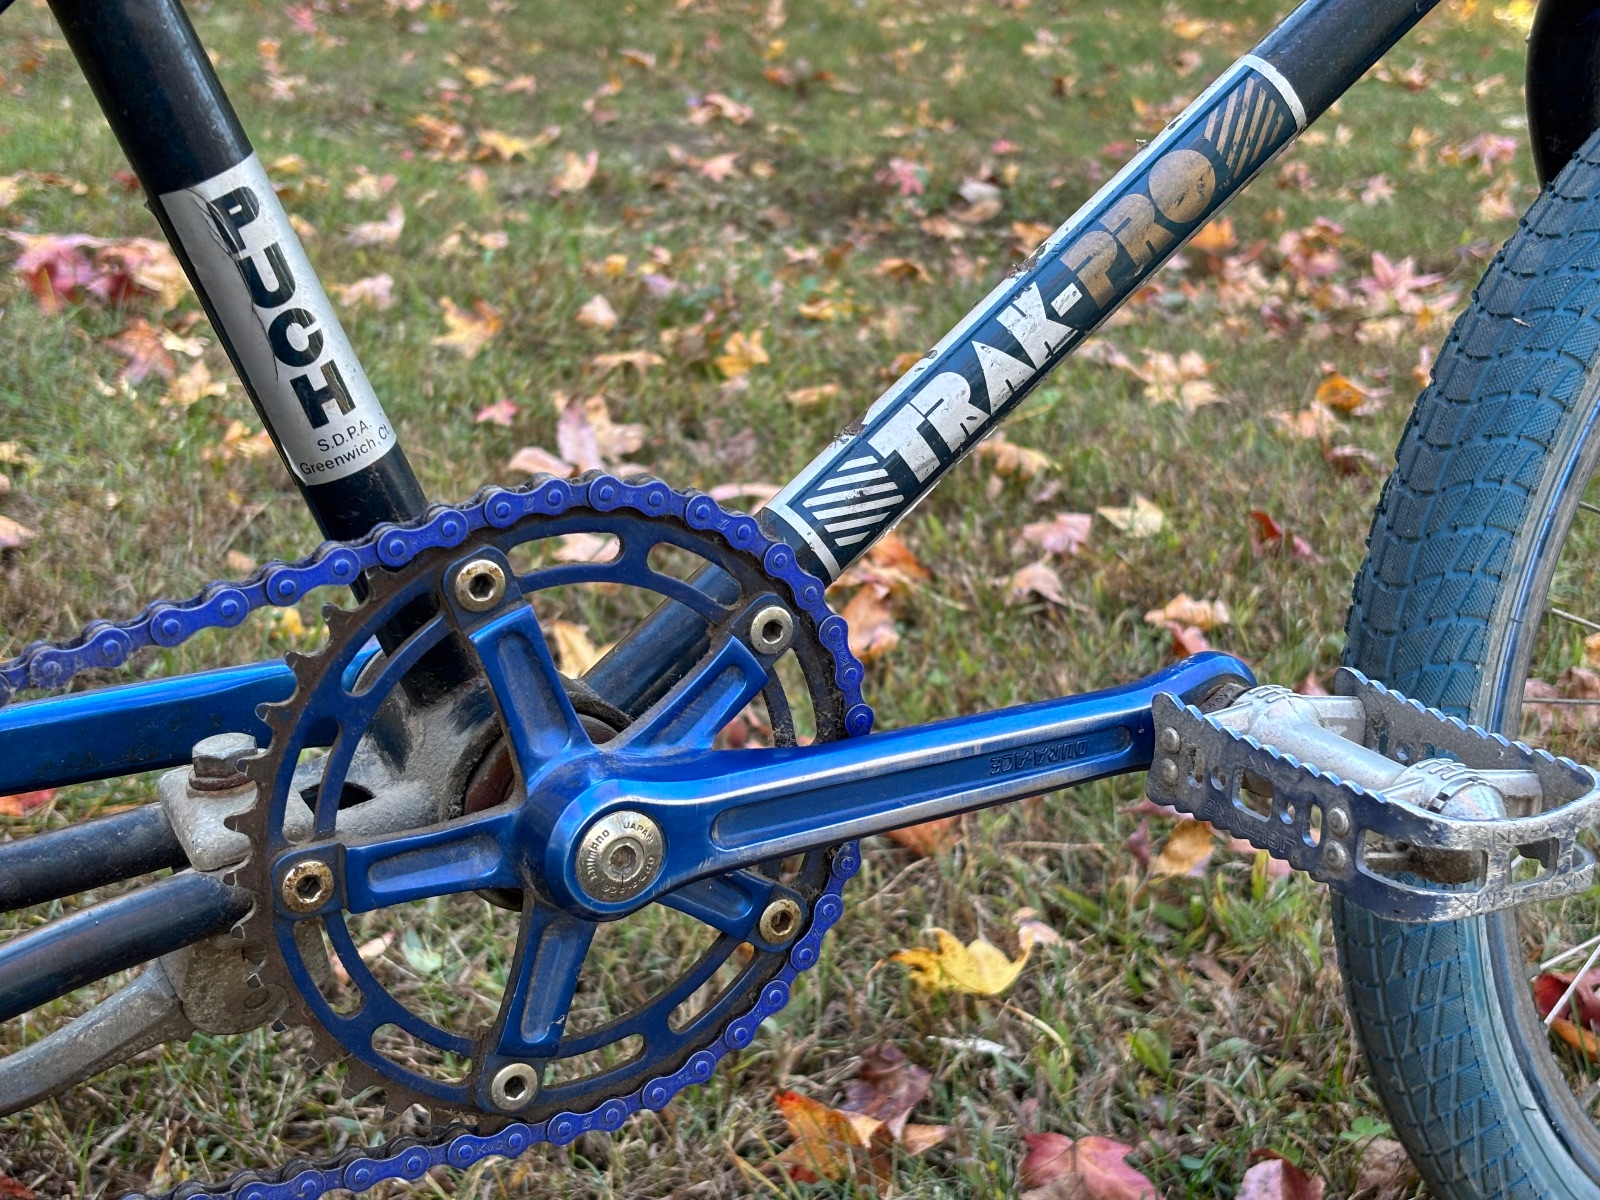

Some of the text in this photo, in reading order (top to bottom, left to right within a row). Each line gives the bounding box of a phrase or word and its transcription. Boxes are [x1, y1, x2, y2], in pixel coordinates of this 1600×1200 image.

[205, 185, 357, 430] PUCH
[317, 419, 373, 452] S.D.P.A.
[299, 438, 382, 475] Greenwich,
[989, 738, 1087, 775] DURA-ACE
[623, 821, 654, 844] JAPAN
